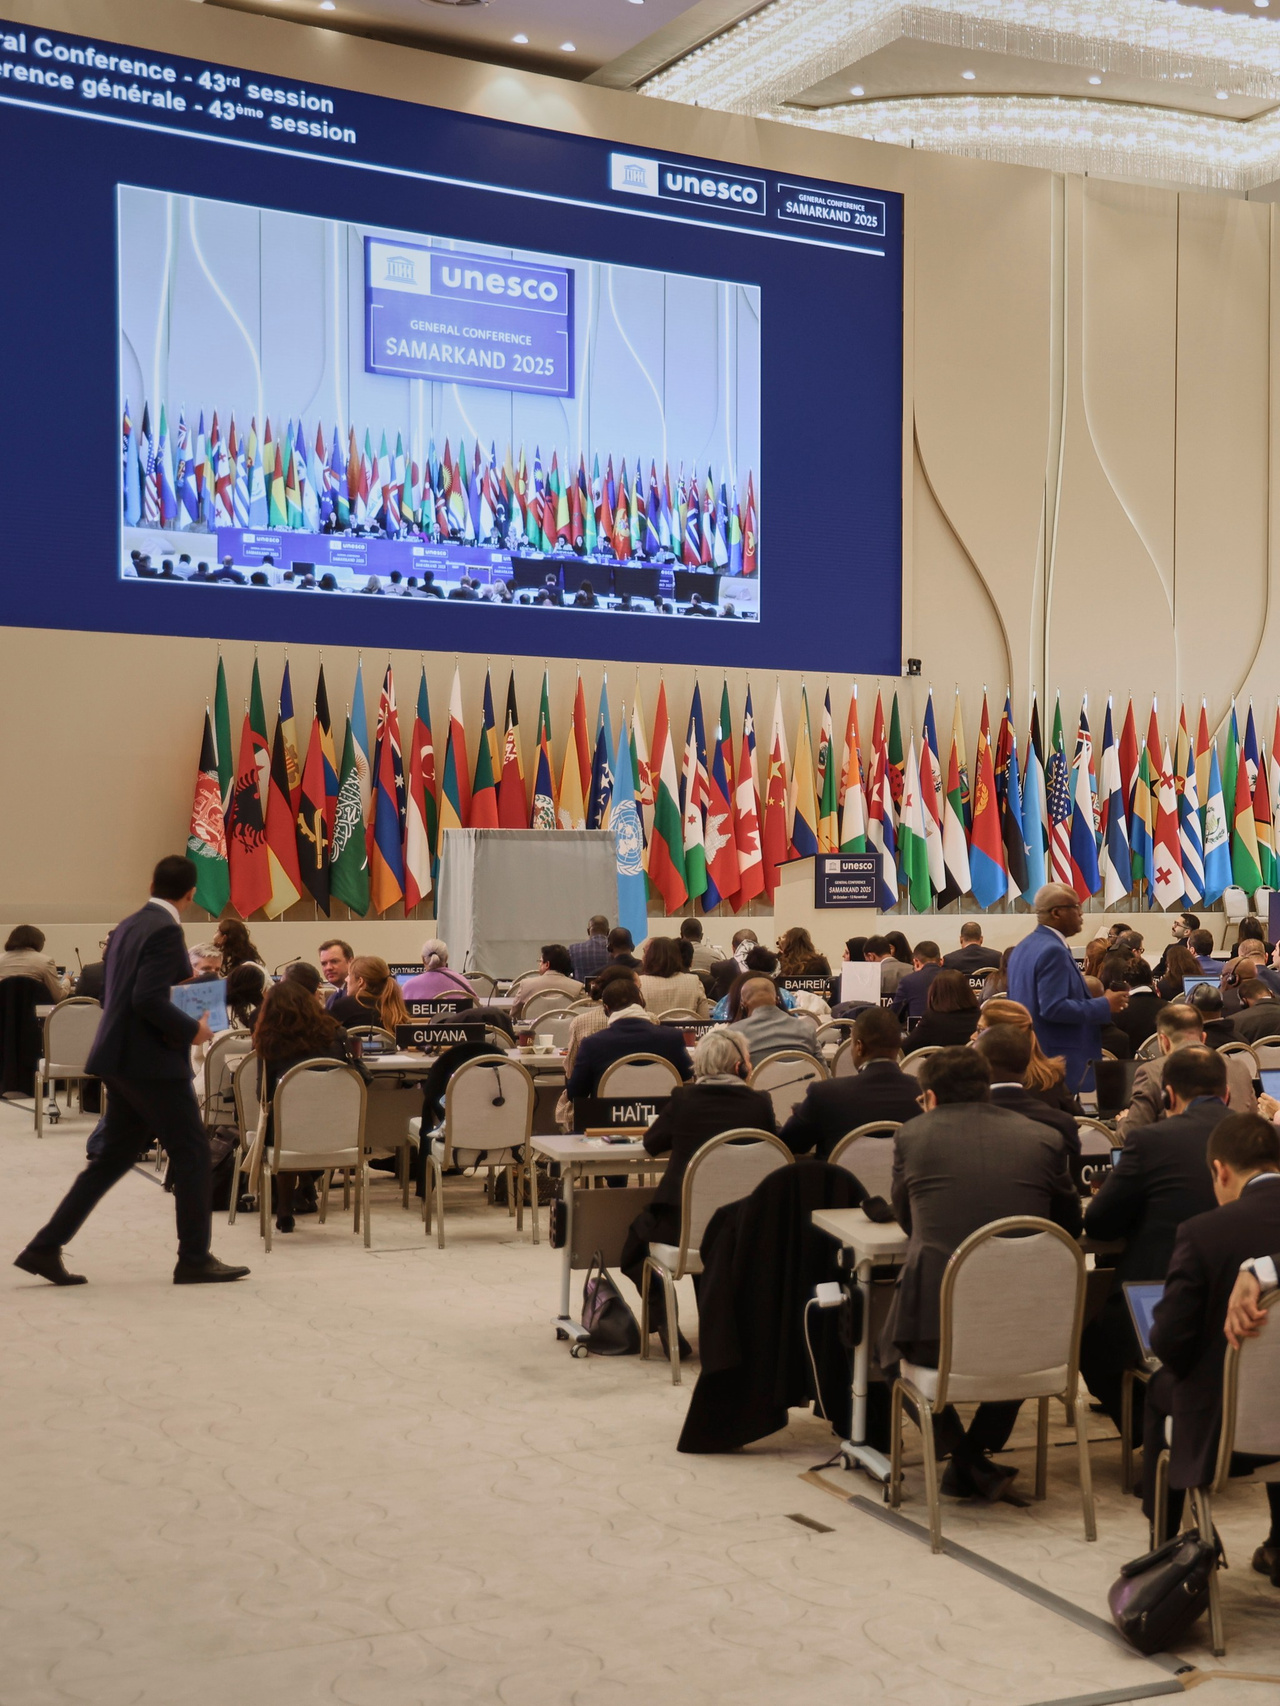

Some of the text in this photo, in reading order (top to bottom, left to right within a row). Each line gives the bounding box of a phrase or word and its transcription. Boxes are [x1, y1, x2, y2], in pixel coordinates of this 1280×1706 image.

[35, 37, 177, 84] Conference
[199, 71, 241, 92] 43rd
[248, 82, 335, 115] session
[0, 60, 75, 91] rence
[82, 77, 187, 111] générale
[270, 113, 356, 144] session
[666, 171, 758, 205] unesco
[785, 201, 878, 228] SAMARKAND 2025
[798, 194, 865, 212] GENERAL CONFERENCE
[442, 266, 558, 302] unesco
[410, 320, 532, 346] GENERAL CONFERENCE
[386, 337, 554, 376] SAMARKAND 2025
[842, 862, 873, 870] unesco
[784, 978, 831, 990] BAHREÏN
[412, 1003, 457, 1015] BELIZE
[413, 1030, 468, 1043] GUYANA
